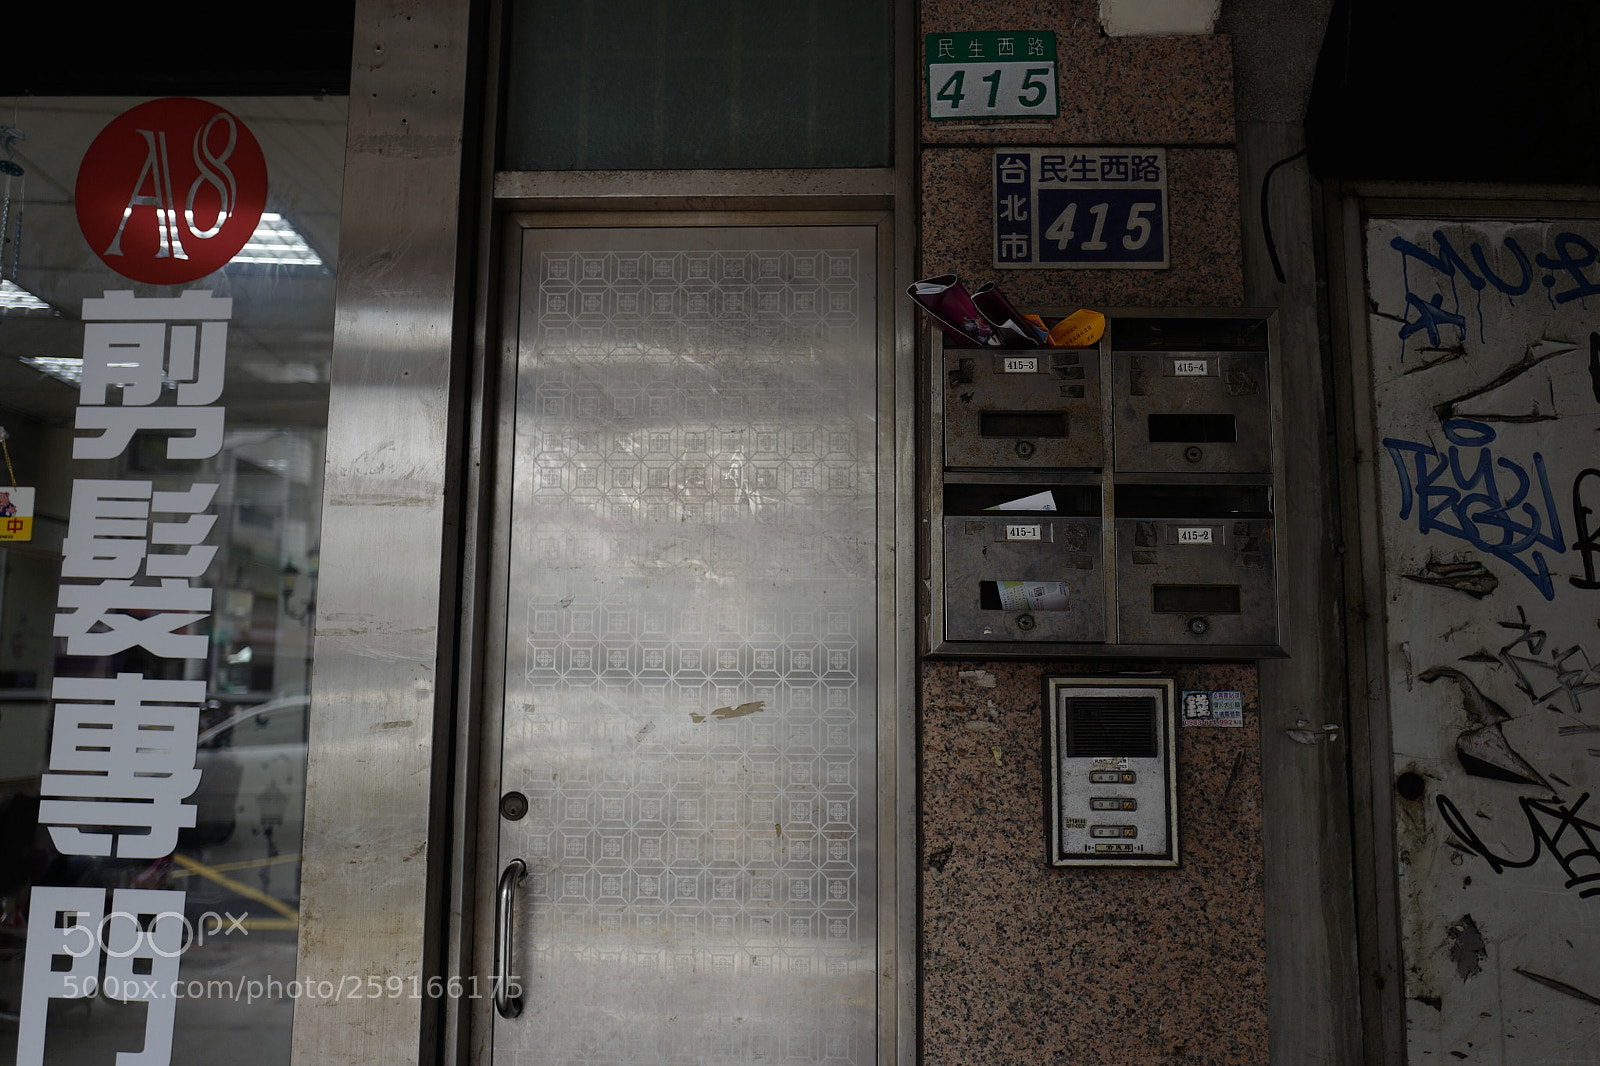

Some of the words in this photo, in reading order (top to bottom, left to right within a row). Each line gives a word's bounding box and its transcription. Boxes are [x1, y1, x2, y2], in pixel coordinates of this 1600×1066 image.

[937, 37, 1044, 58] 民生西路
[937, 69, 1049, 109] 415
[1038, 155, 1160, 182] 民生西路
[103, 113, 238, 260] A8
[1000, 157, 1028, 259] 台北市
[1045, 202, 1156, 250] 415
[1007, 361, 1034, 370] 415-3
[1177, 363, 1204, 372] 415-4
[7, 518, 24, 534] 中
[1009, 527, 1036, 537] 415-1
[1181, 531, 1209, 540] 415-2
